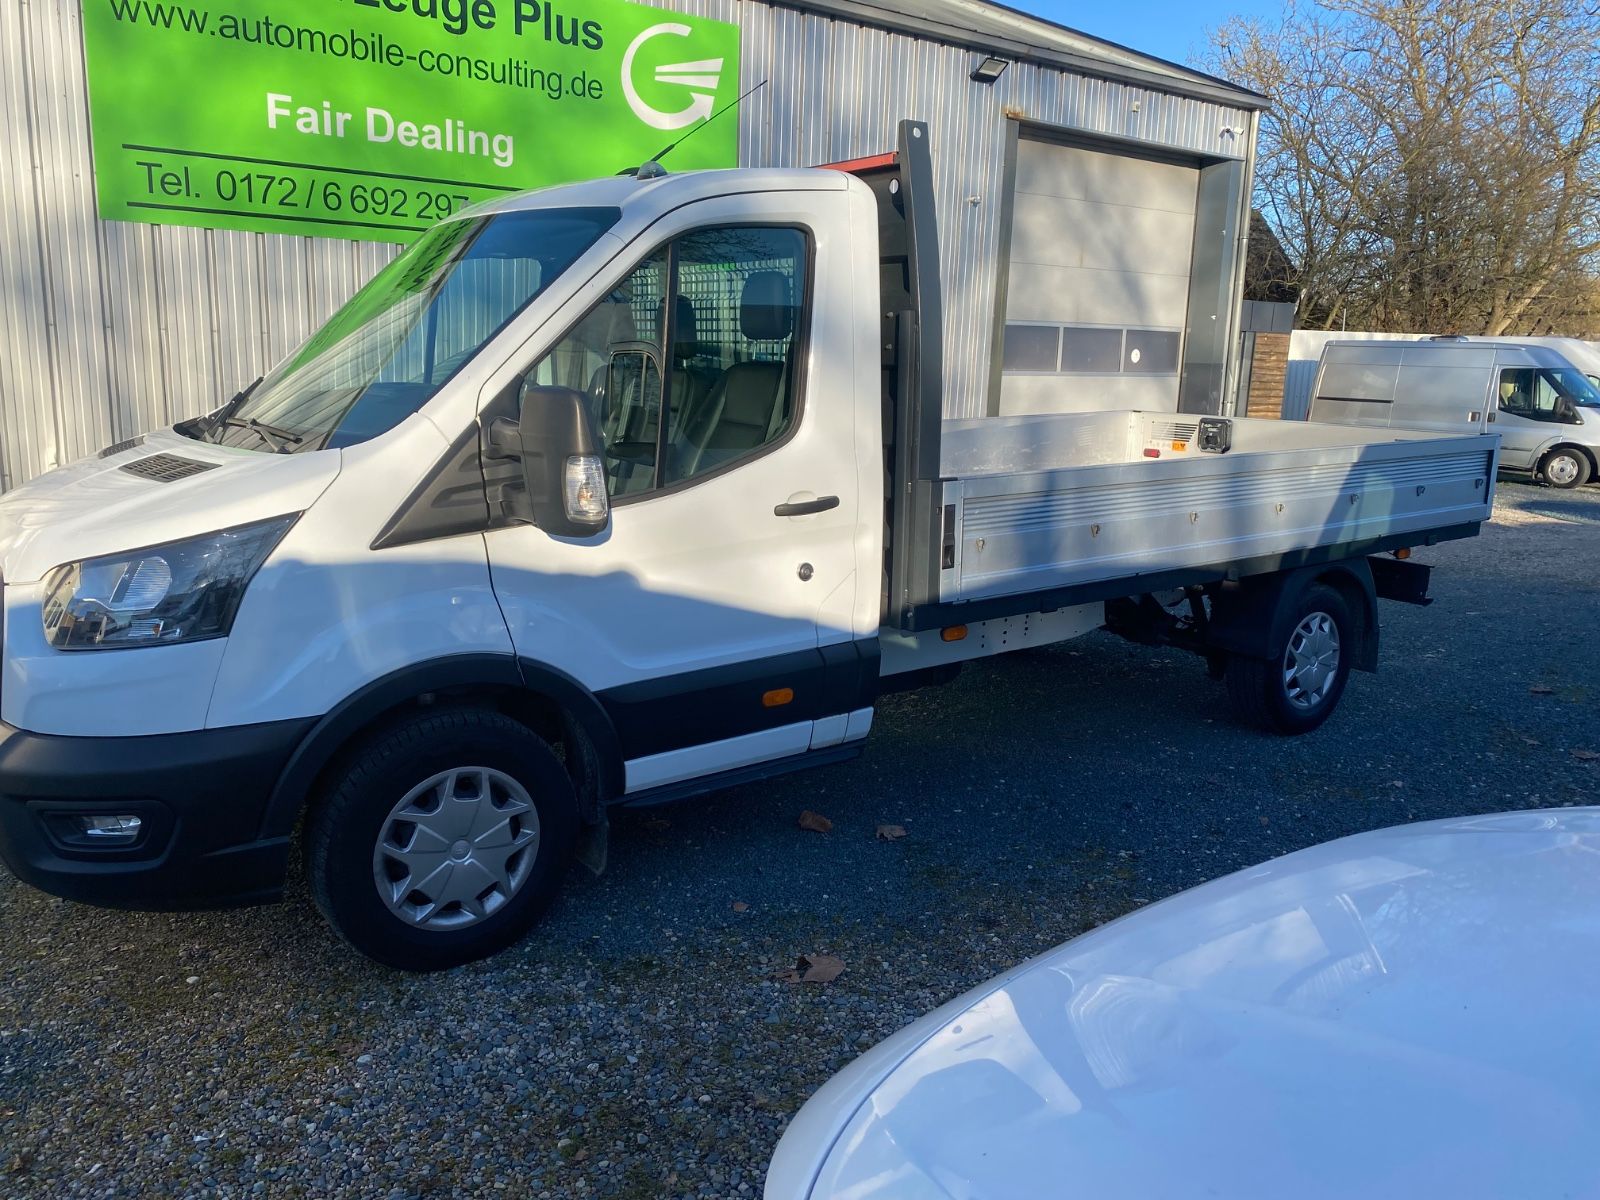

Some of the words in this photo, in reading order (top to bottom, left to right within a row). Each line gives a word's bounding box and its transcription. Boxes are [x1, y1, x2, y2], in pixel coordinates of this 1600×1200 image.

[110, 0, 603, 100] www.automobile-consulting.de
[514, 0, 604, 50] Plus
[266, 92, 352, 138] Fair
[366, 107, 514, 168] Dealing
[136, 161, 201, 198] Tel.
